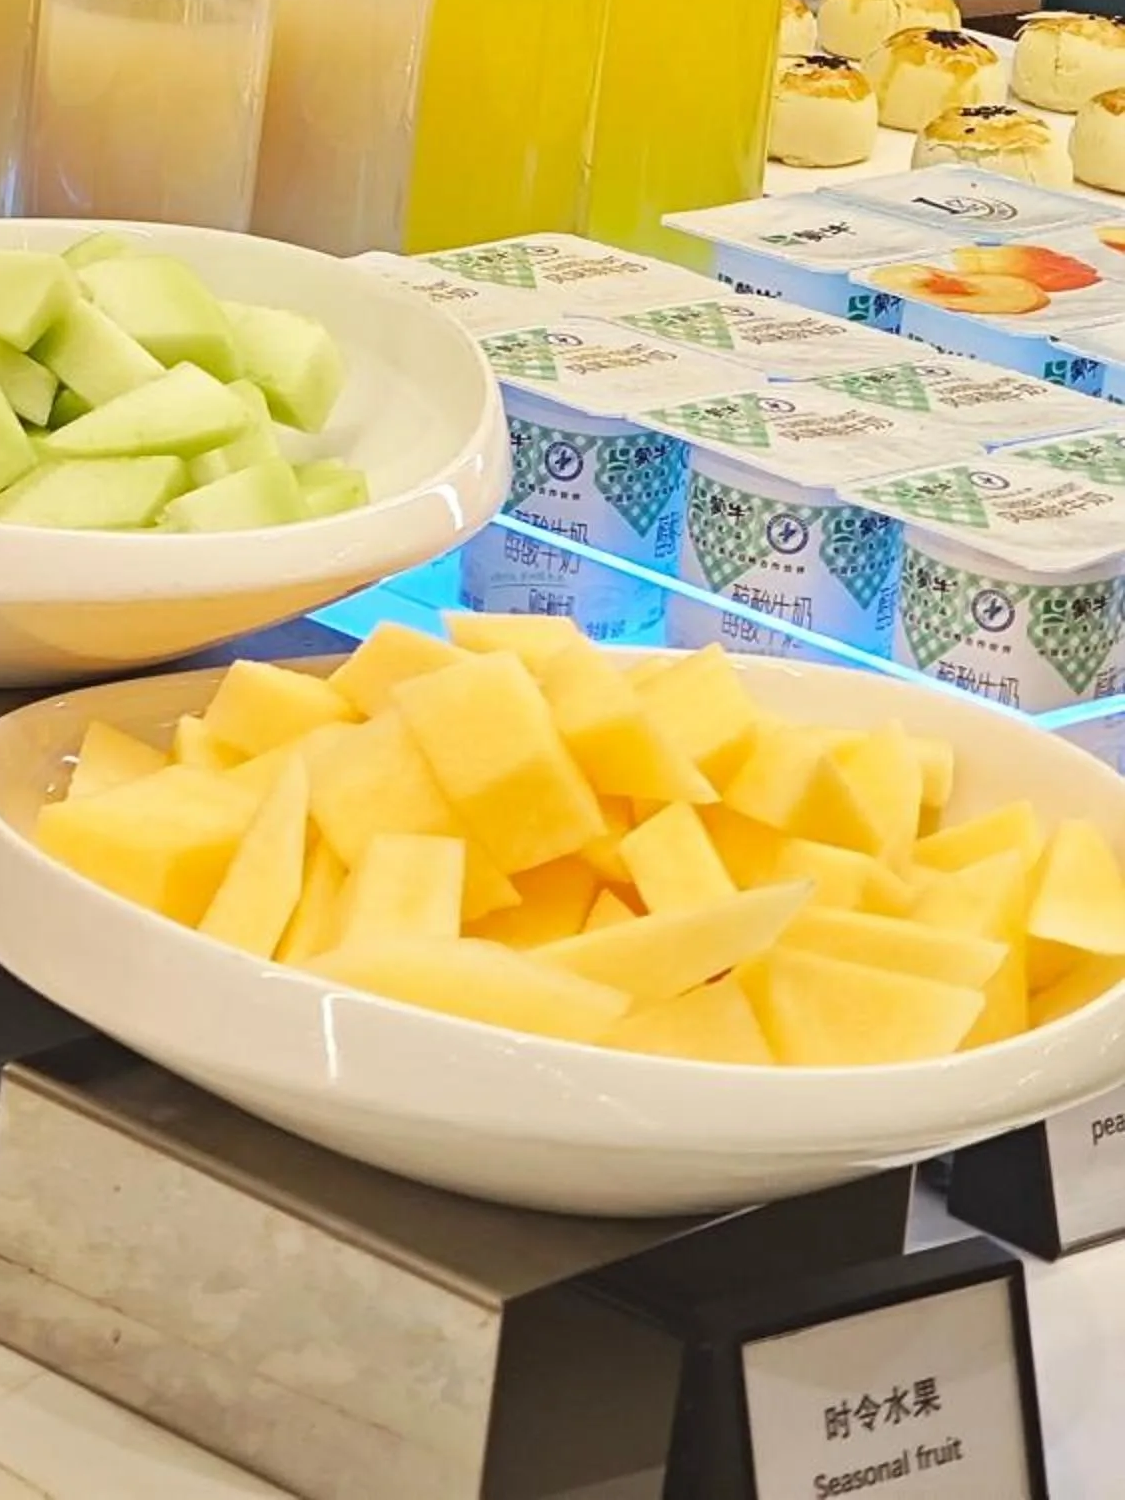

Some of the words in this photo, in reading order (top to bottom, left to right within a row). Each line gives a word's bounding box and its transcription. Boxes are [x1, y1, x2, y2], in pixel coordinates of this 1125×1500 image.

[824, 1376, 942, 1441] 时令水果
[813, 1450, 910, 1500] Seasonal
[915, 1436, 963, 1471] fruit
